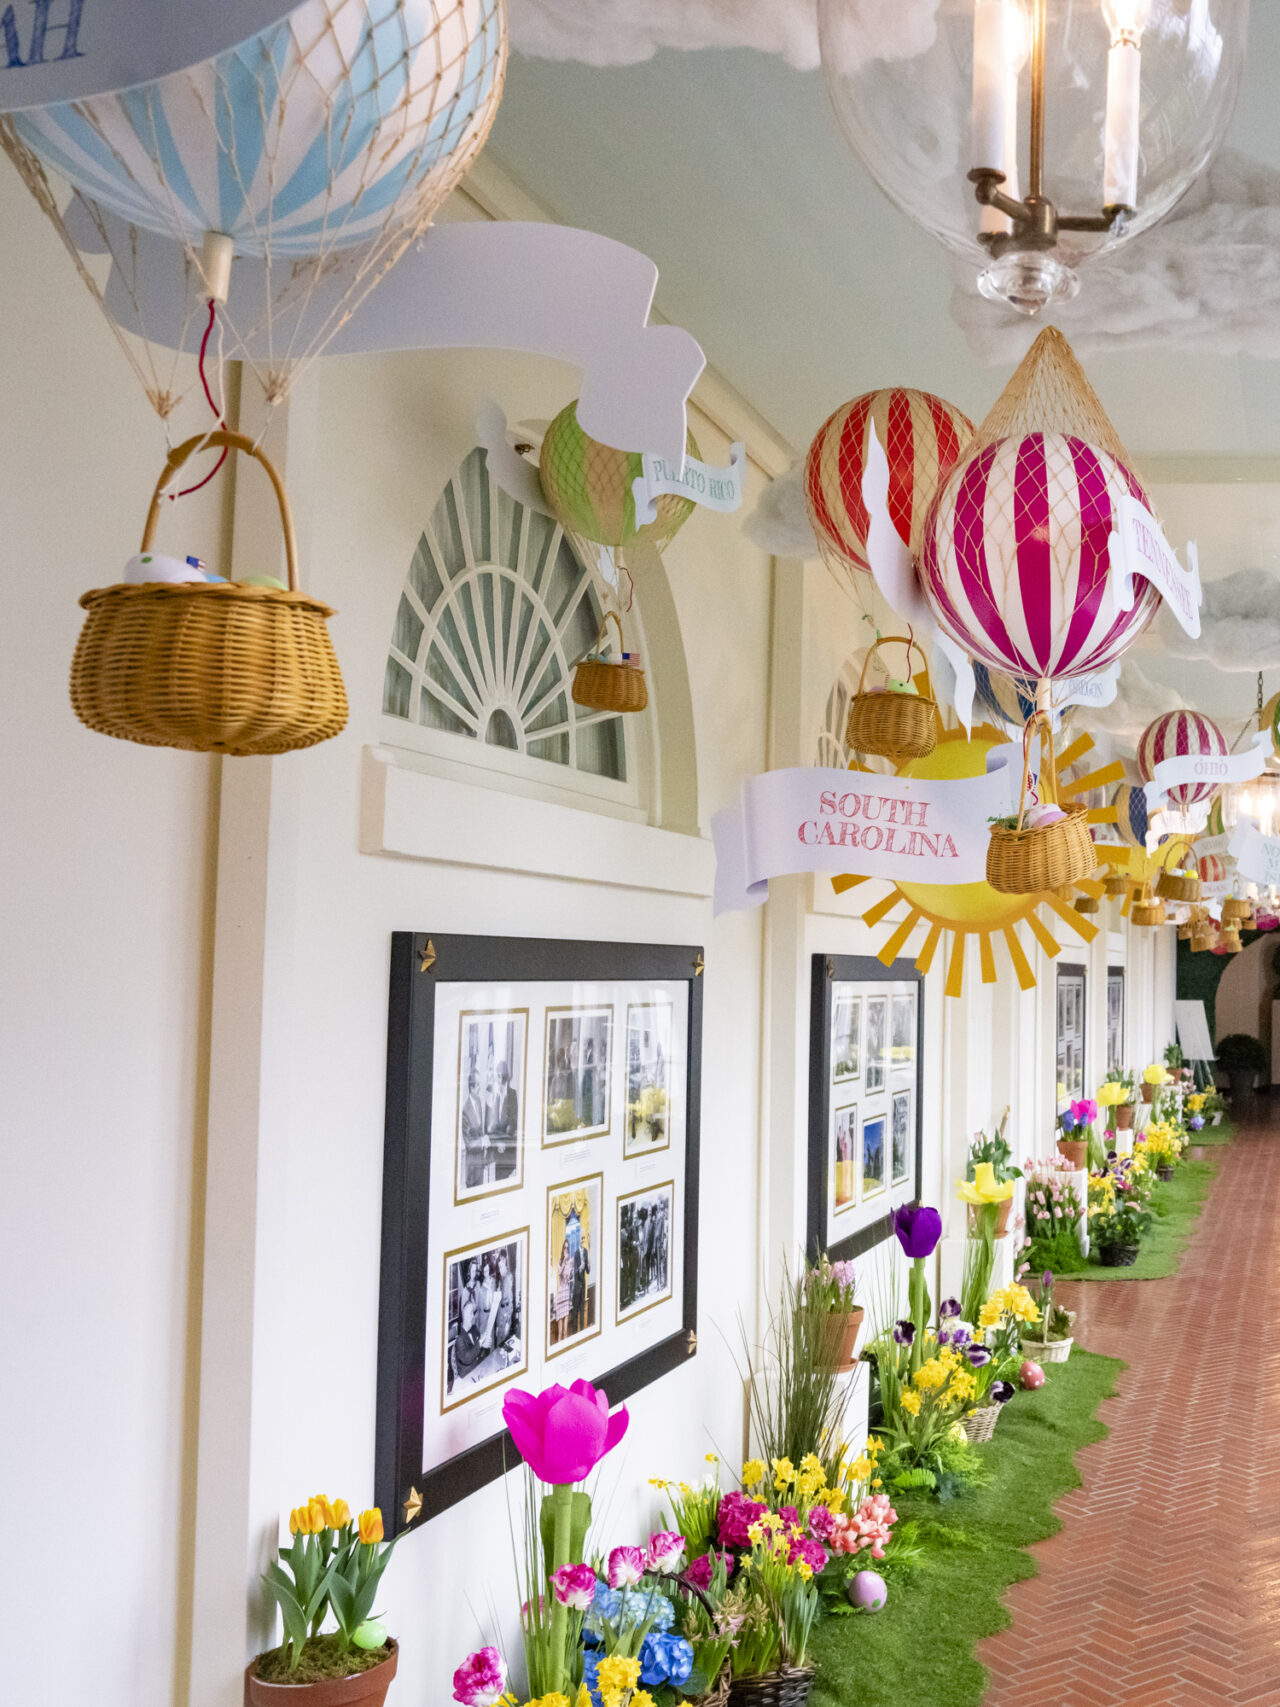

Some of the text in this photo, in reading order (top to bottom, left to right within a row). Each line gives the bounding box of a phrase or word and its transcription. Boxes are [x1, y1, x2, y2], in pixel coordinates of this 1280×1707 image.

[709, 478, 735, 500] RICO
[1193, 761, 1229, 776] OHIO
[819, 790, 931, 827] SOUTH
[797, 820, 960, 858] CAROLINA
